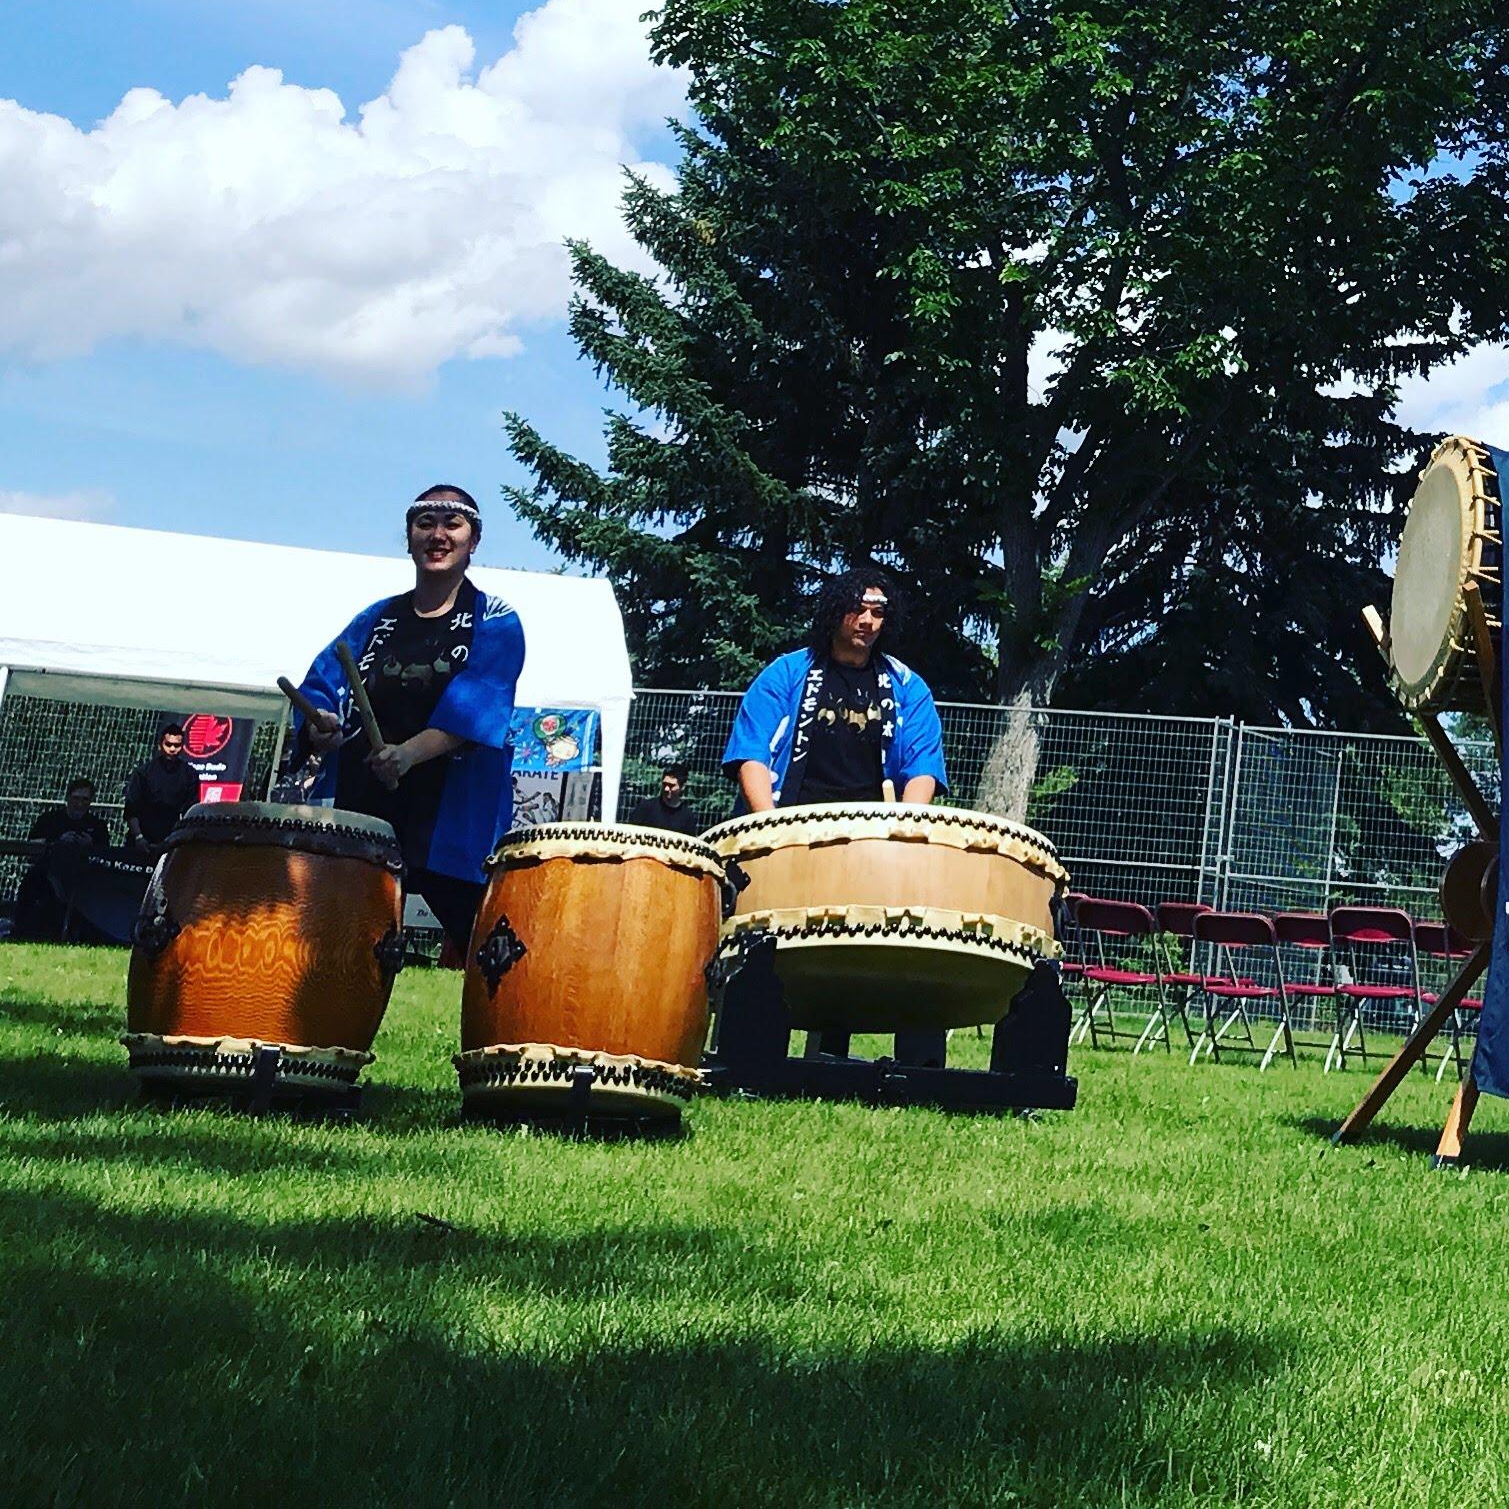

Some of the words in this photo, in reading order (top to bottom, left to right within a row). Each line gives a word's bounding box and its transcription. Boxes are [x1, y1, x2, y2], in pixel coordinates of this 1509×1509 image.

[343, 618, 397, 741] エドモトン
[793, 669, 823, 762] エドモントン
[878, 672, 895, 764] 北の太
